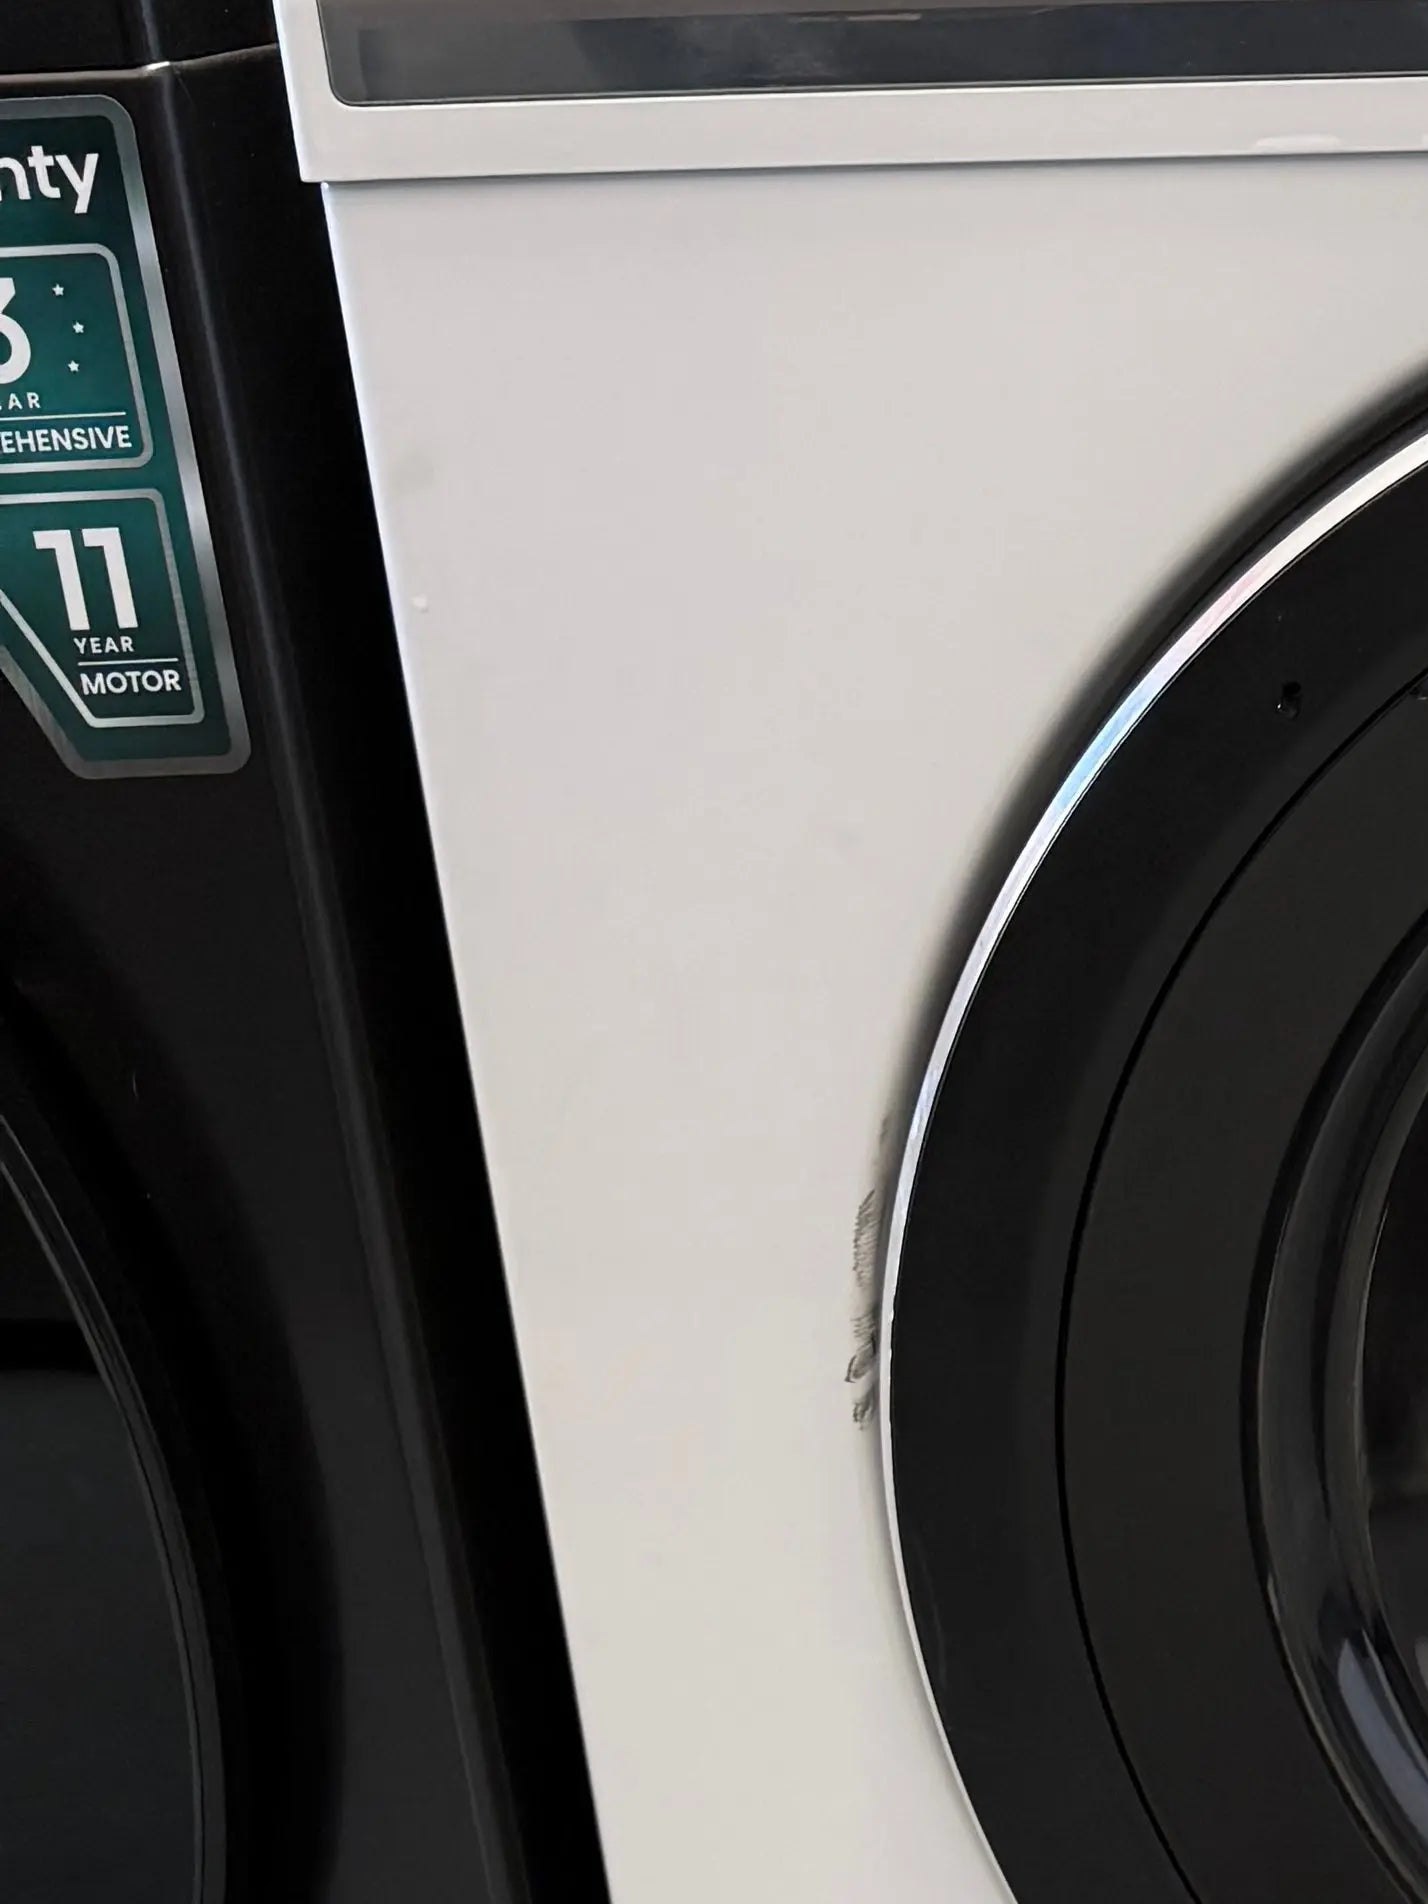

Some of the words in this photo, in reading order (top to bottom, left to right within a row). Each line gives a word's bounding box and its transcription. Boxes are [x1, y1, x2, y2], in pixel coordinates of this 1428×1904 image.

[0, 426, 132, 453] EHENSIVE
[33, 527, 138, 630] 11
[74, 636, 133, 654] YEAR
[80, 670, 181, 695] MOTOR
